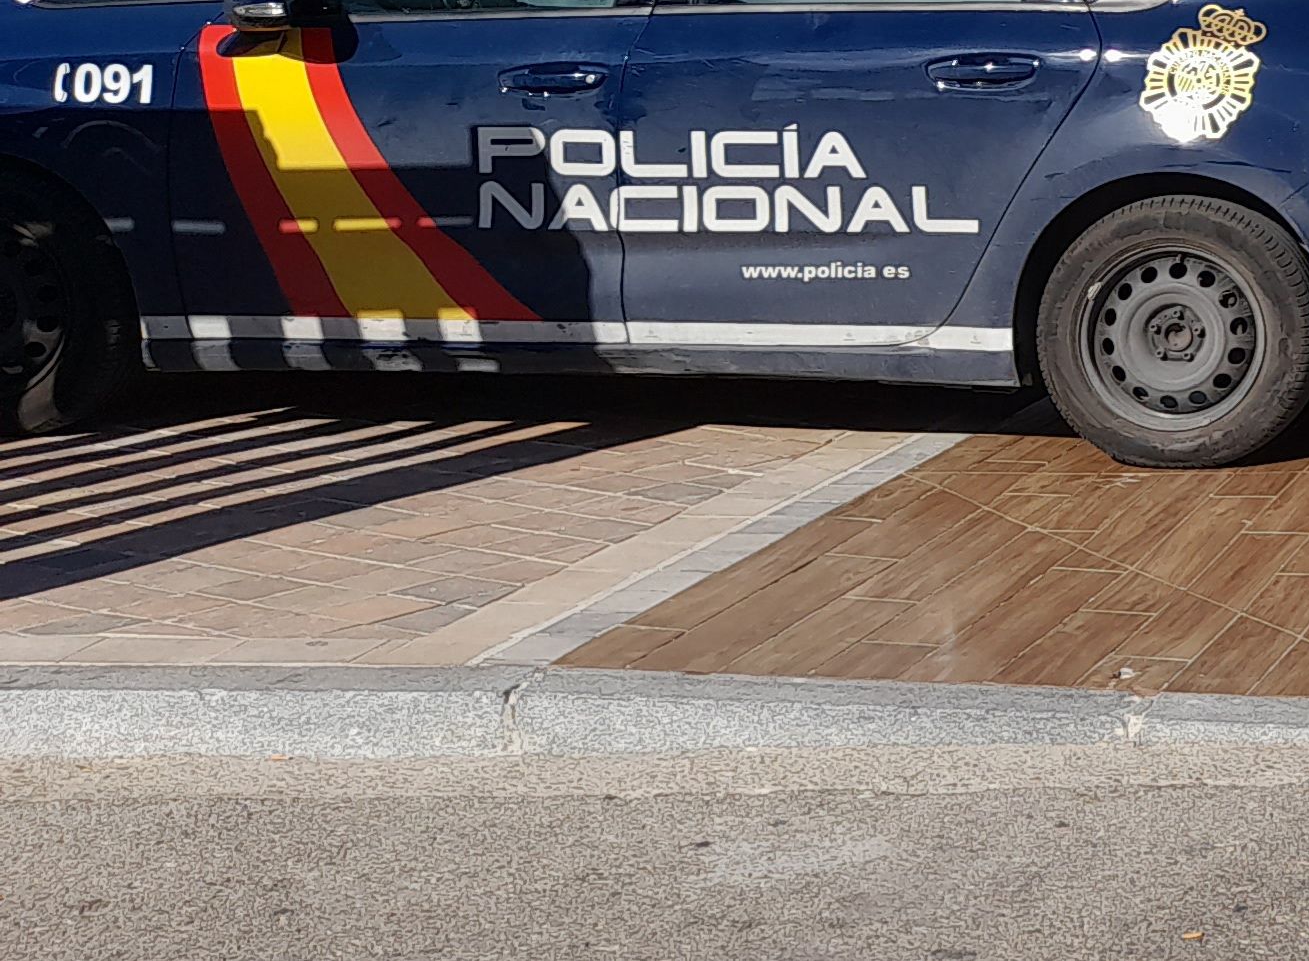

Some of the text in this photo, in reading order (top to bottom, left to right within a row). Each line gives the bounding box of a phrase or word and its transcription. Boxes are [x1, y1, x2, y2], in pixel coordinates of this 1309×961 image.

[74, 62, 153, 104] 091
[477, 124, 868, 179] POLICÍA
[478, 181, 980, 233] NACIONAL
